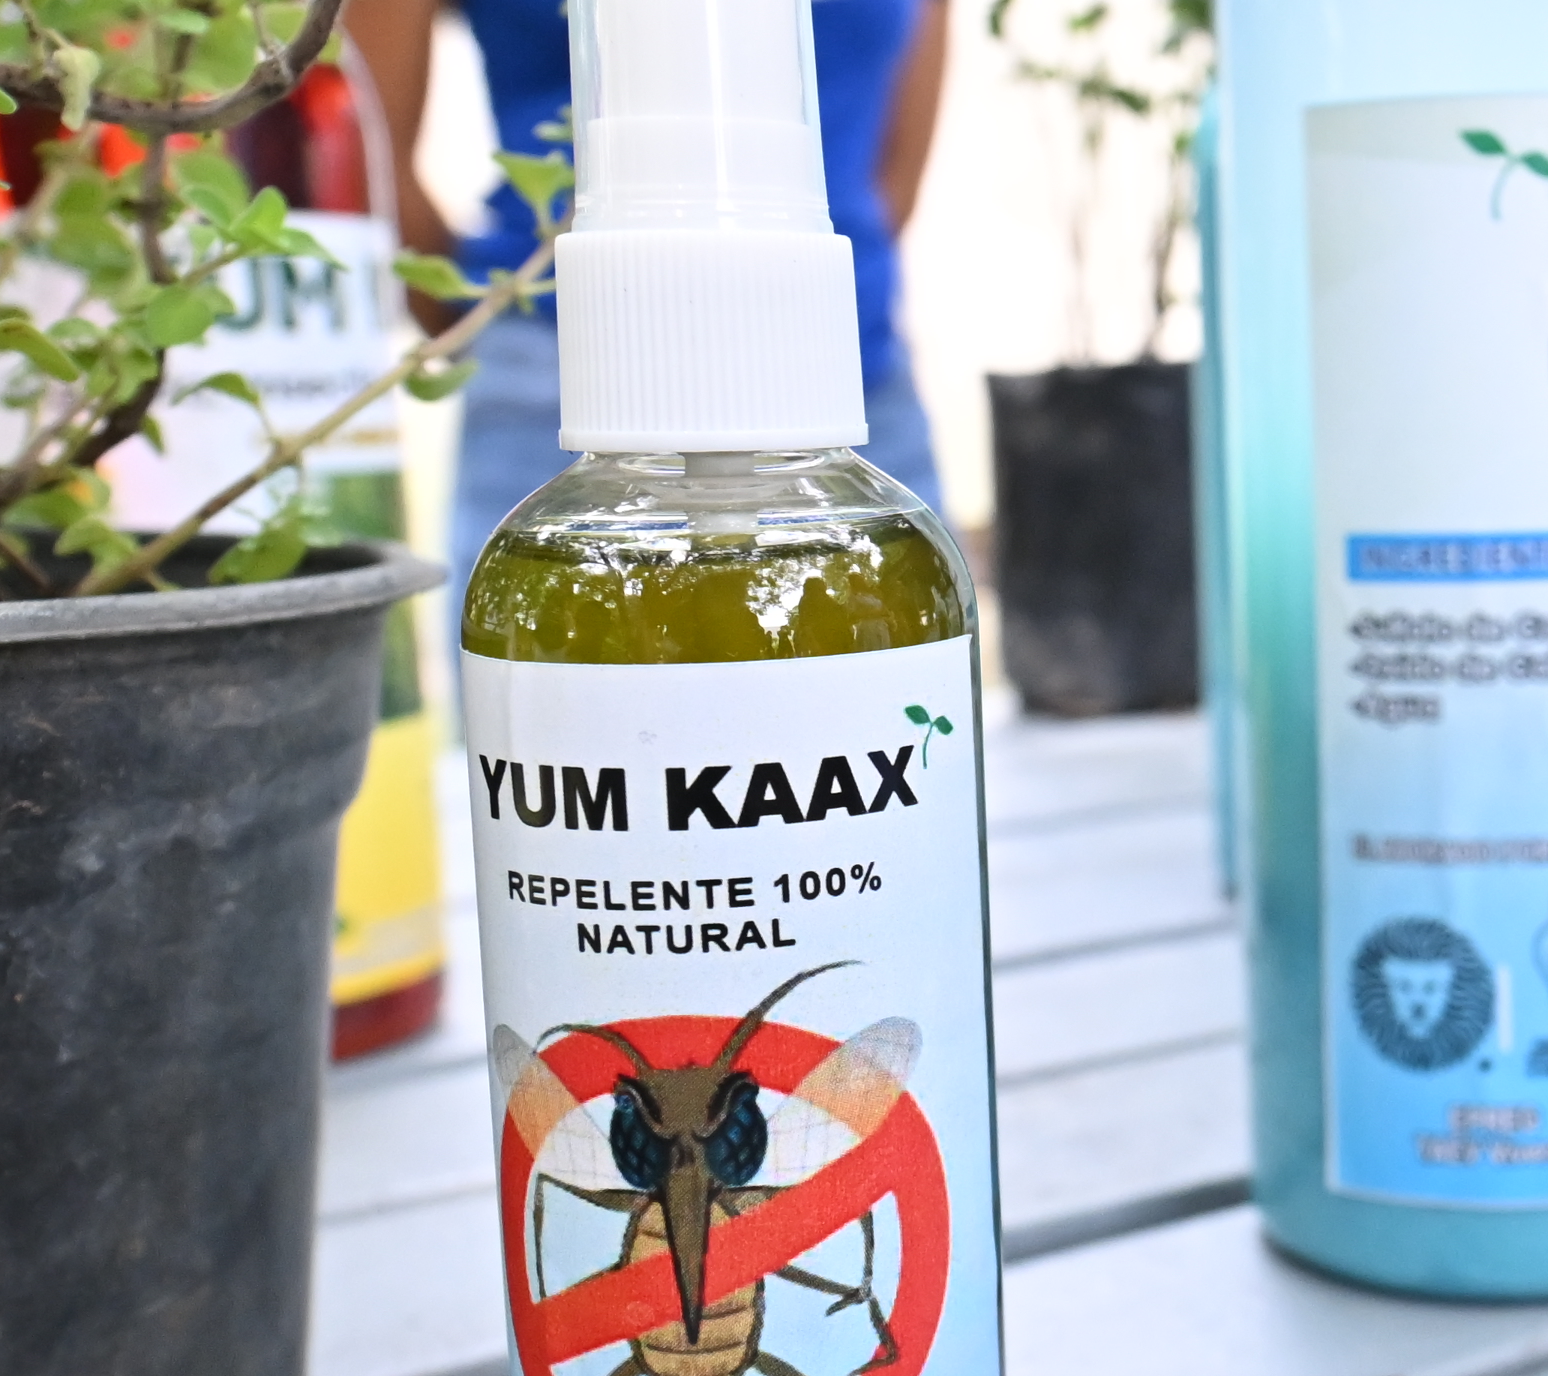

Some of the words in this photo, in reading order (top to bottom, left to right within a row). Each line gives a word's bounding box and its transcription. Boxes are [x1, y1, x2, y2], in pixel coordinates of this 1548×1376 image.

[479, 754, 629, 831] YUM
[665, 745, 919, 831] KAAX
[508, 870, 755, 911] REPELENTE
[773, 861, 882, 903] 100%
[577, 918, 796, 955] NATURAL
